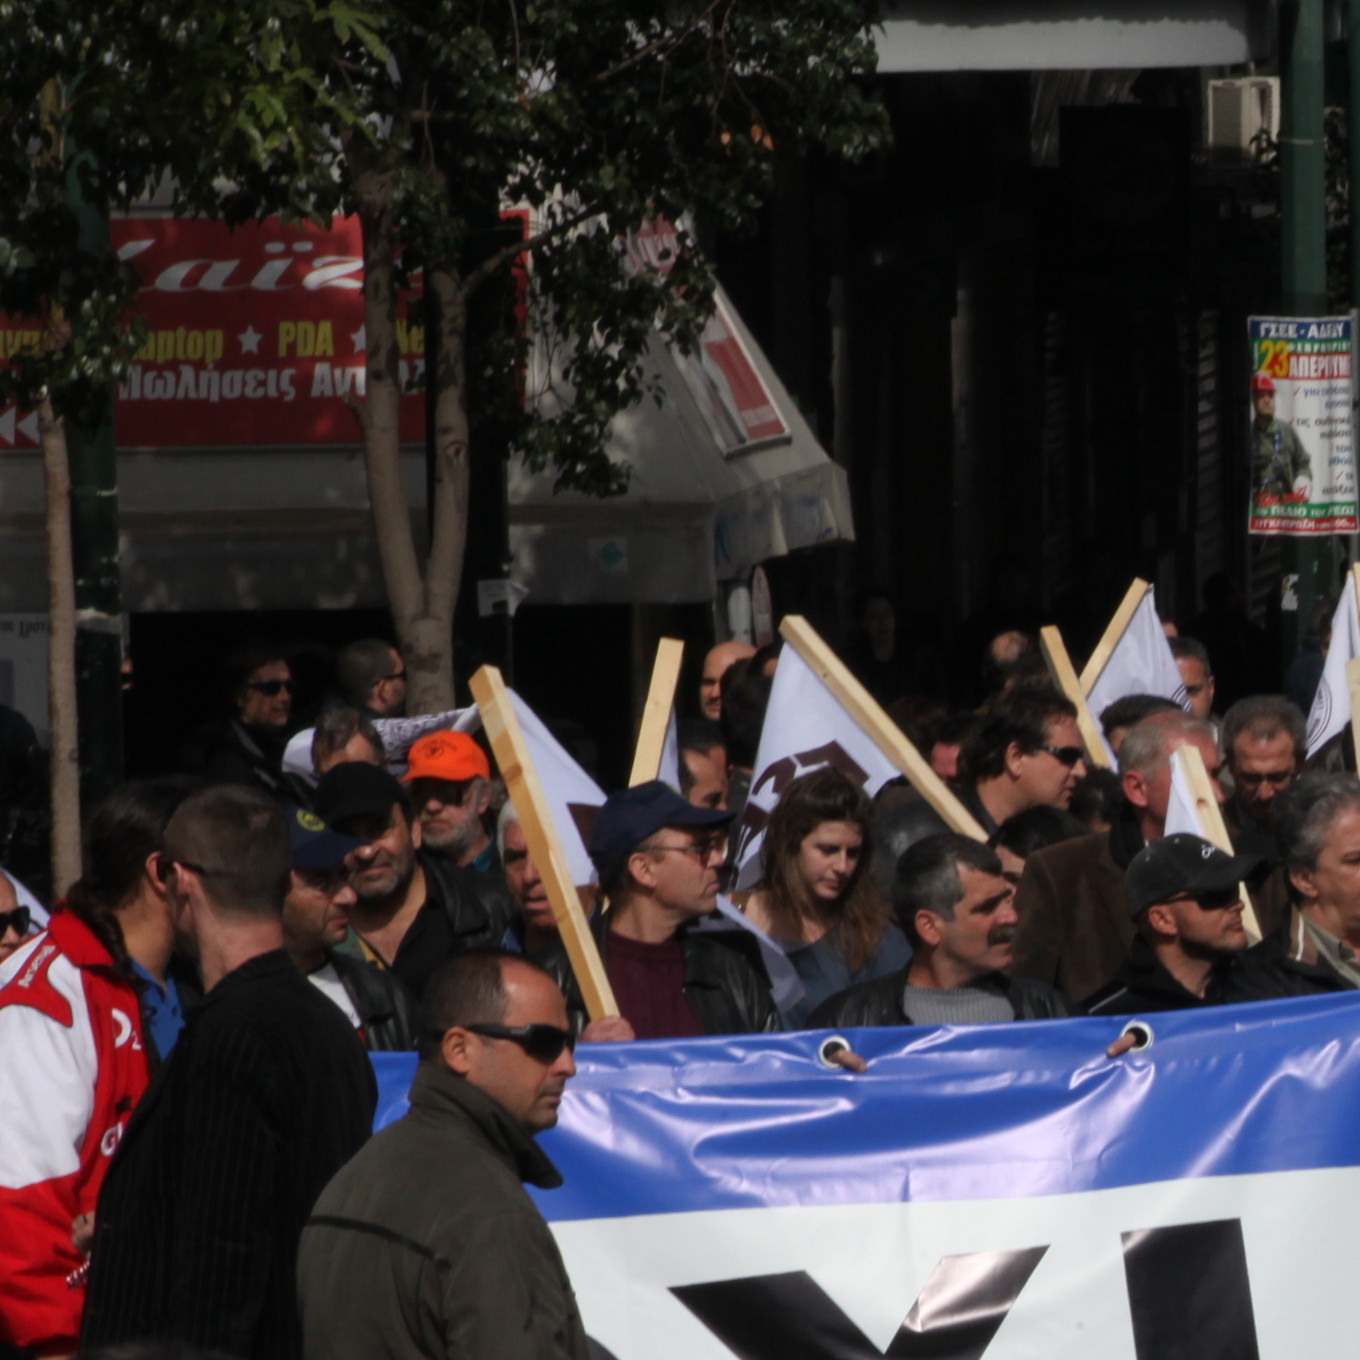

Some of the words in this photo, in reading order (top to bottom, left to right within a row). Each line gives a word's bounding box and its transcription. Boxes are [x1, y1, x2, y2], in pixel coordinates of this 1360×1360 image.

[277, 320, 334, 358] PDA
[1259, 322, 1299, 339] ΓΣΕΕ
[1260, 340, 1289, 377] 23
